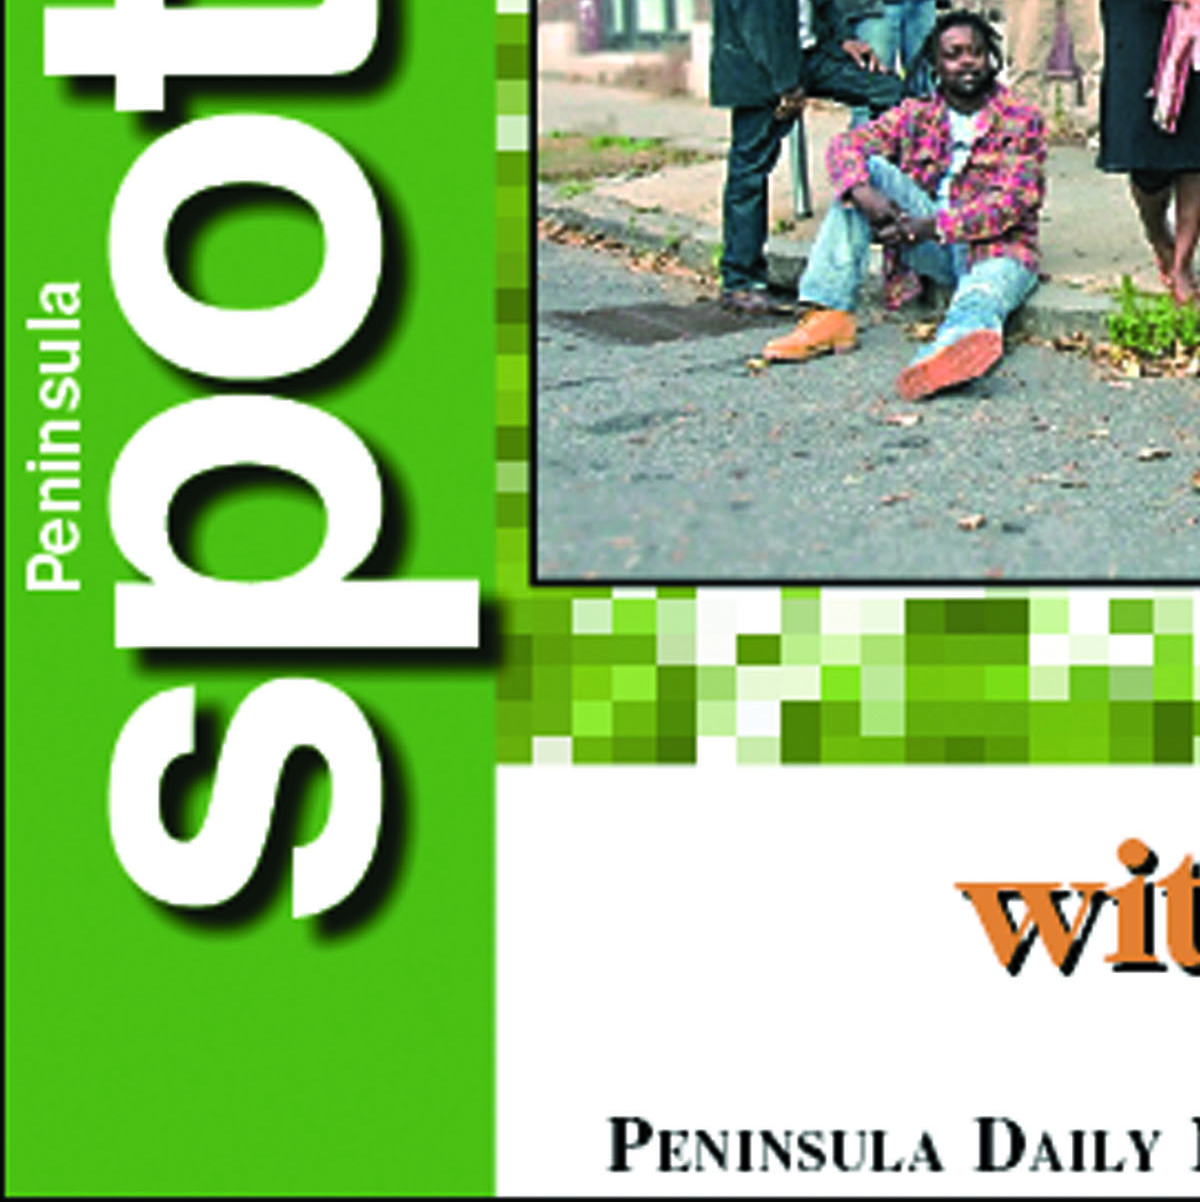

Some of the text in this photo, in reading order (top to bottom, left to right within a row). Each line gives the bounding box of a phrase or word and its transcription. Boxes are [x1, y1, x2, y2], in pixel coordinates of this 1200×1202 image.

[27, 283, 80, 590] Peninsula
[609, 1116, 943, 1173] PENINSULA
[976, 1116, 1160, 1173] DAILY
